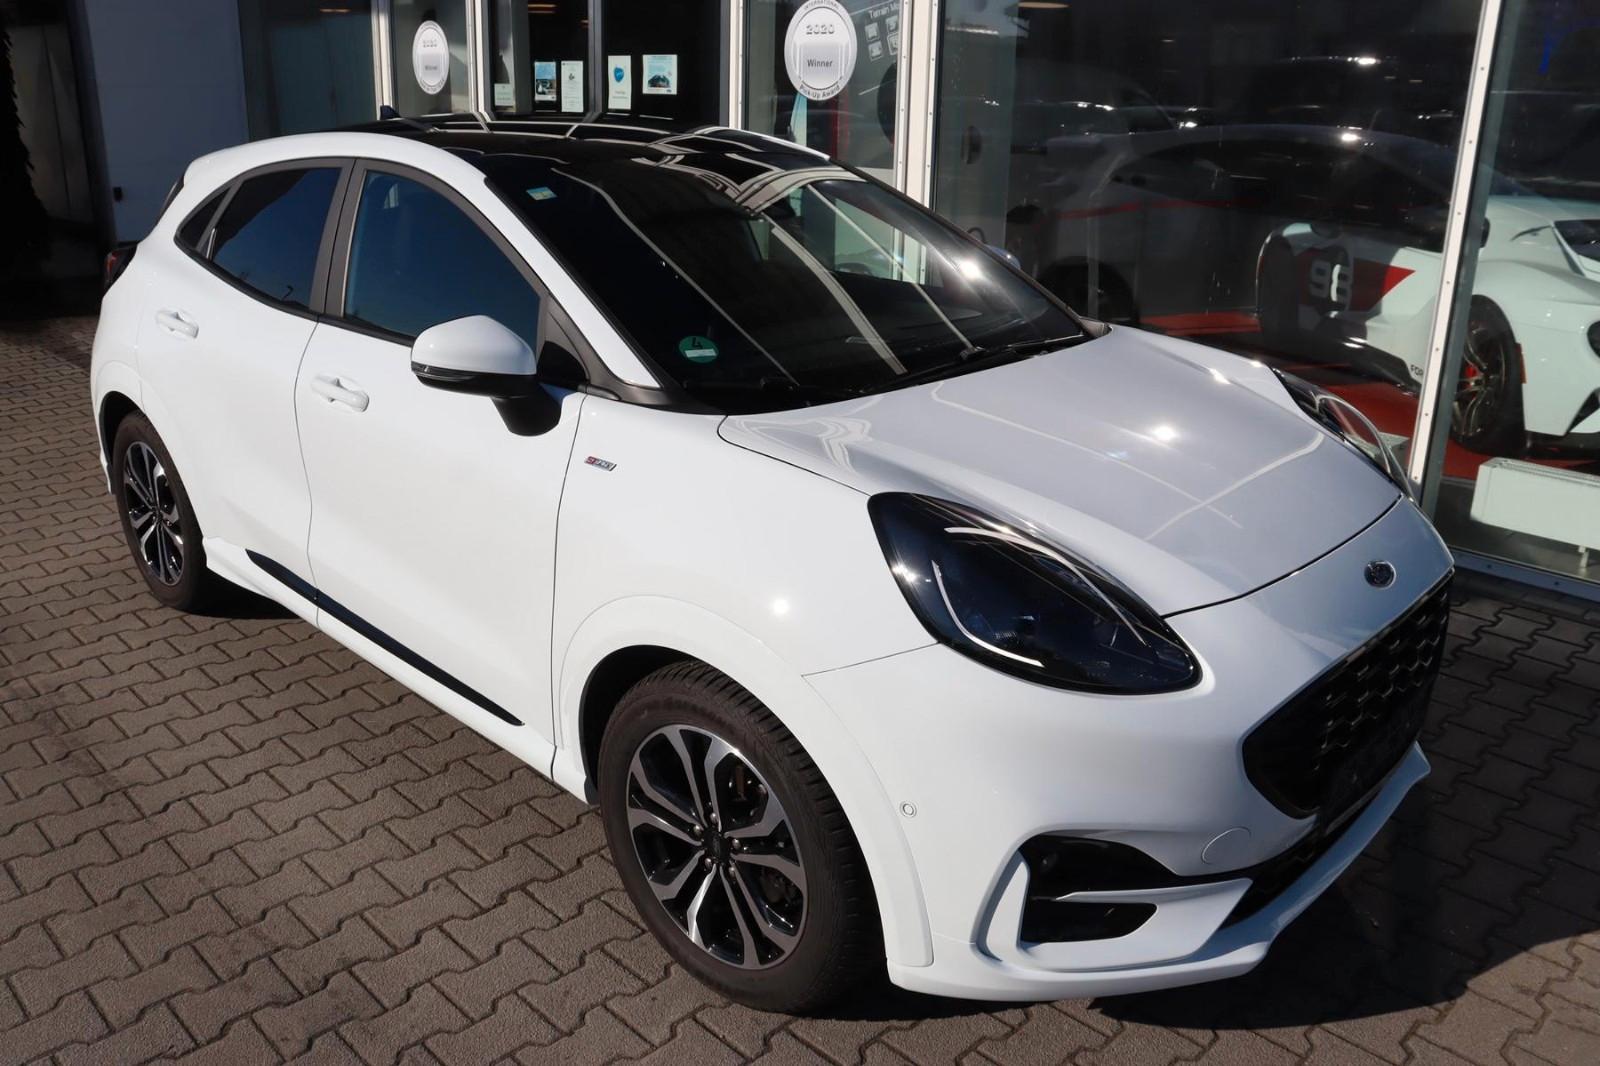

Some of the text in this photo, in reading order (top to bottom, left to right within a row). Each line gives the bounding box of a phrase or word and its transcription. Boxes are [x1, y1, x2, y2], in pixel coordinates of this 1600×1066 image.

[806, 24, 835, 35] 2020
[807, 58, 833, 68] Winner
[822, 84, 841, 97] Award
